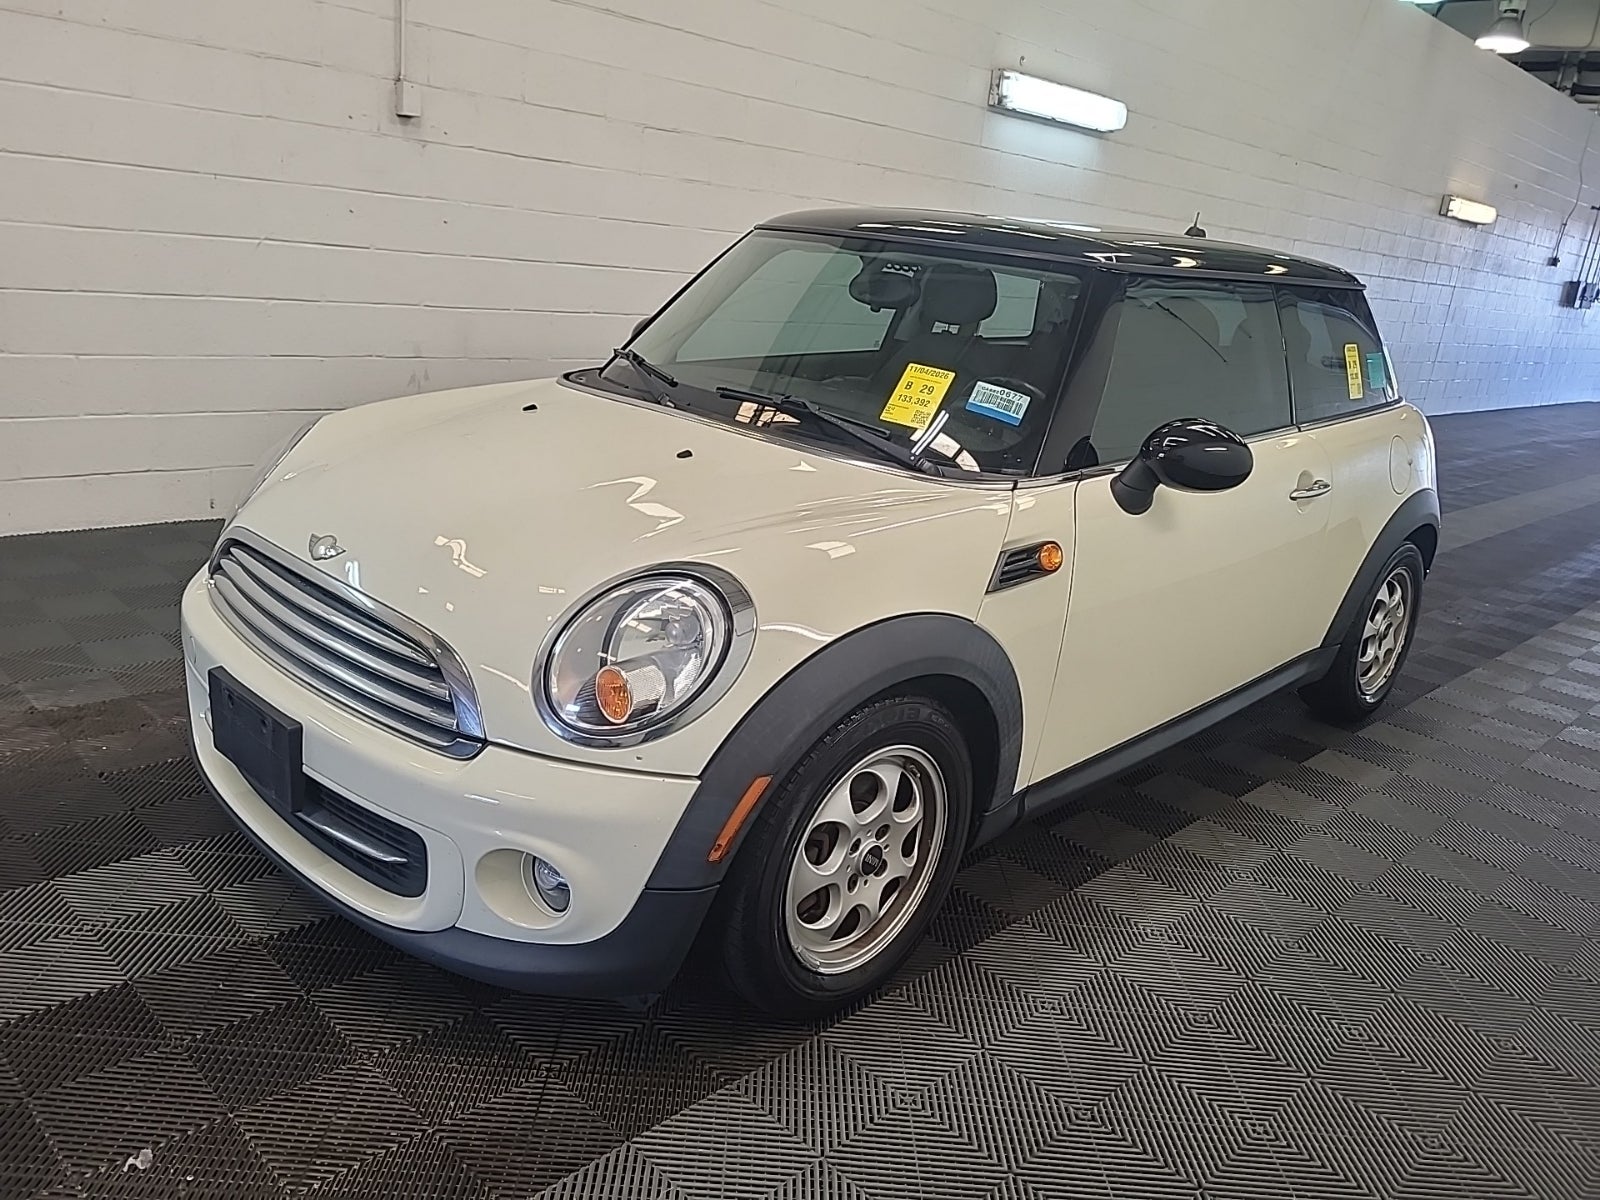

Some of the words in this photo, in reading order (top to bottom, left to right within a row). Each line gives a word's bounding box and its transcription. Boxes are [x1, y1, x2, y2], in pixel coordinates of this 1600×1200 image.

[909, 365, 950, 380] 11/04/2026
[904, 380, 914, 390] B
[919, 384, 935, 395] 29
[897, 393, 931, 408] 133,392
